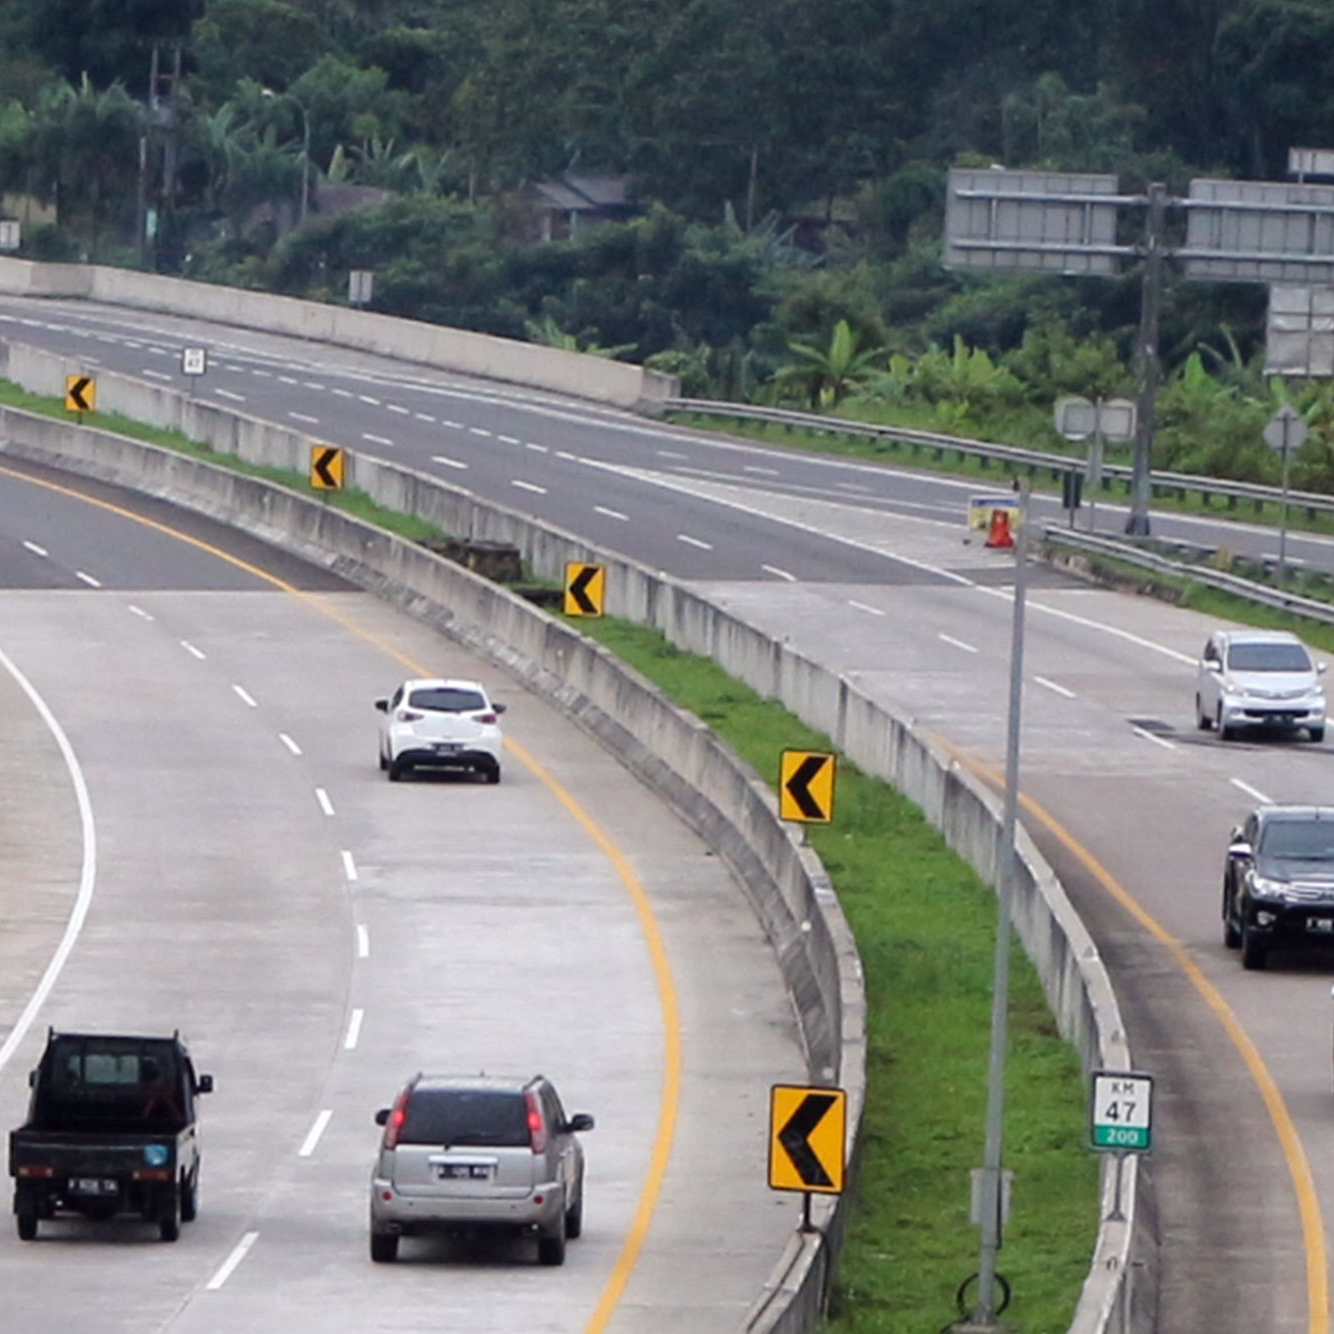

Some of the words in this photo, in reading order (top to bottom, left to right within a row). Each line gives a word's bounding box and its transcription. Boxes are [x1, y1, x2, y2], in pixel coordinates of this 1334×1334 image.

[1111, 1082, 1135, 1095] KM
[1105, 1100, 1137, 1123] 47
[1106, 1128, 1139, 1143] 200
